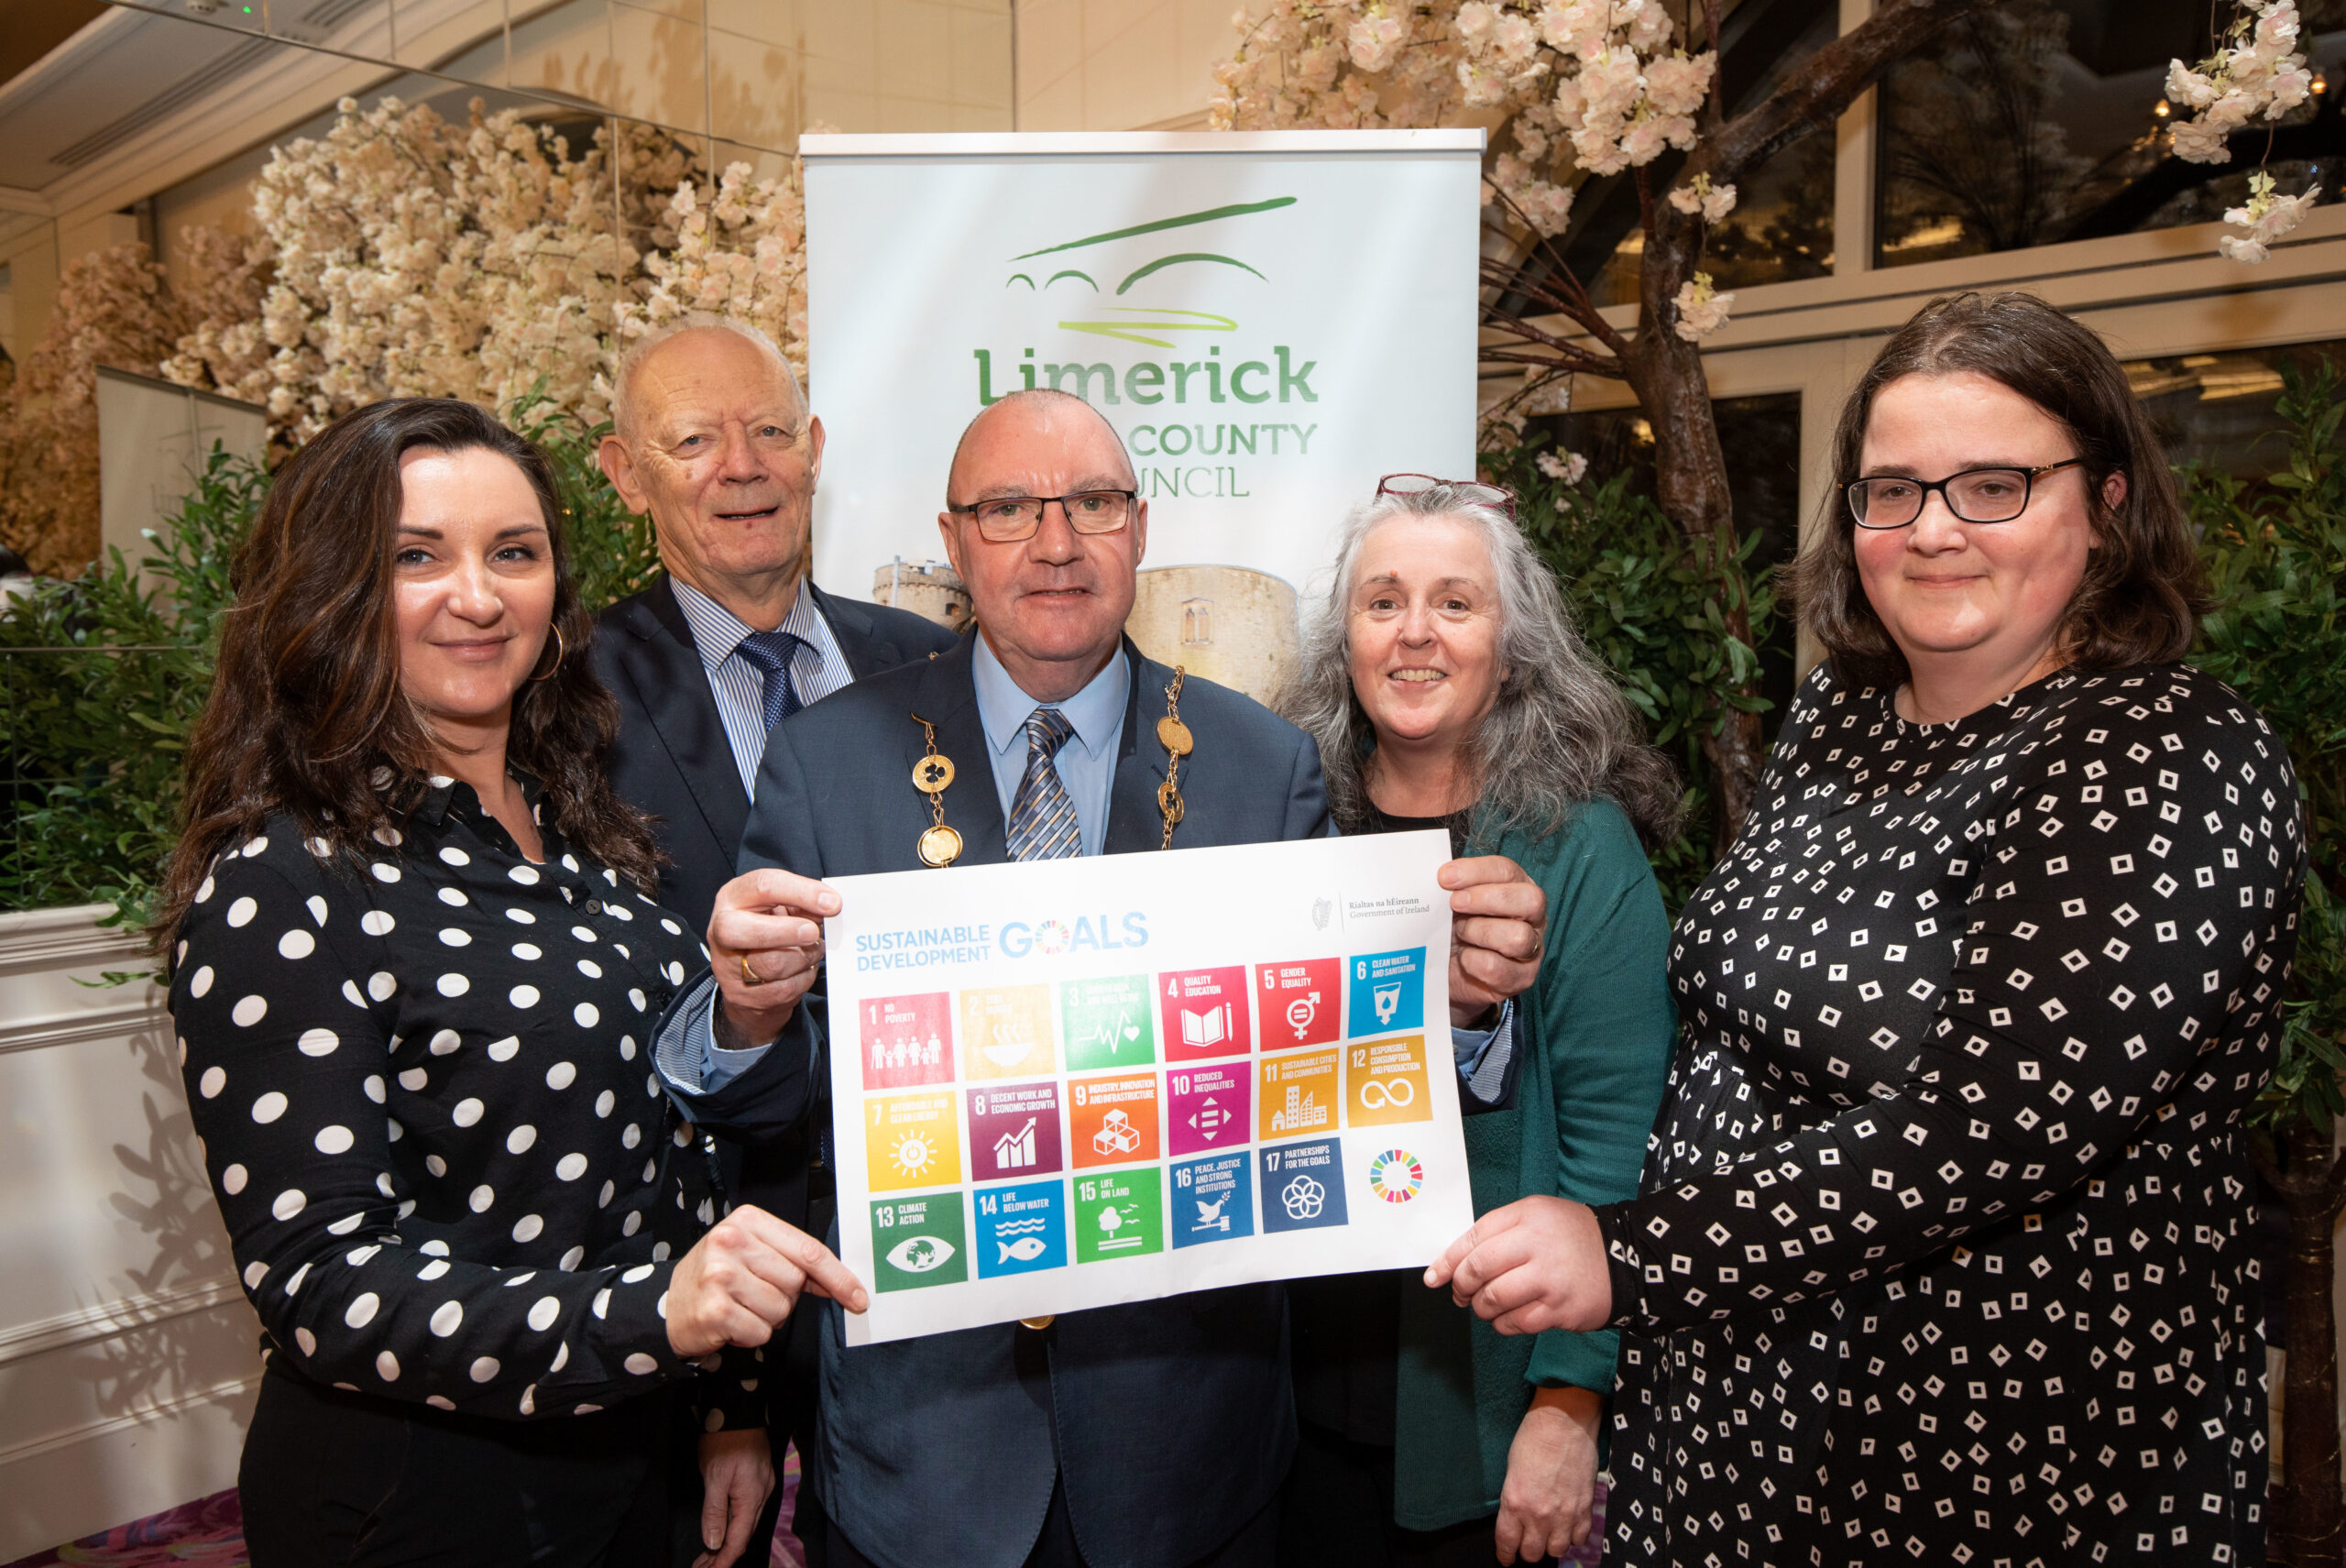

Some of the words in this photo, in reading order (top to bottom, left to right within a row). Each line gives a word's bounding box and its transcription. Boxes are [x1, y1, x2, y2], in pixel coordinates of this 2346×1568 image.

[973, 345, 1319, 405] Limerick
[1128, 423, 1318, 456] COUNTY
[1349, 901, 1375, 910] Rialtas
[1350, 909, 1395, 919] Government
[1396, 906, 1404, 915] of
[1405, 905, 1430, 915] Ireland
[856, 925, 991, 953] SUSTAINABLE
[999, 910, 1149, 959] GOALS
[857, 945, 991, 972] DEVELOPMENT
[1372, 958, 1391, 969] CLEAN
[1391, 955, 1410, 966] WATER
[1280, 967, 1306, 978] GENDER
[1357, 960, 1366, 980] 6
[1372, 969, 1385, 978] AND
[1385, 963, 1416, 976] SANITATION
[1184, 975, 1211, 987] QUALITY
[1264, 969, 1275, 990] 5
[1281, 977, 1311, 989] EQUALITY
[1168, 978, 1178, 998] 4
[1185, 984, 1222, 997] EDUCATION
[1069, 987, 1080, 1007] 3
[884, 1003, 895, 1013] NO
[969, 996, 979, 1016] 2
[869, 1004, 877, 1025] 1
[884, 1012, 915, 1025] POVERTY
[1370, 1043, 1408, 1056] RESPONSIBLE
[1281, 1057, 1320, 1070] SUSTAINABLE
[1320, 1054, 1337, 1064] CITIES
[1352, 1049, 1366, 1068] 12
[1370, 1053, 1411, 1065] CONSUMPTION
[1265, 1063, 1277, 1082] 11
[1282, 1070, 1294, 1080] AND
[1294, 1064, 1332, 1078] COMMUNITIES
[1371, 1064, 1384, 1075] AND
[1384, 1062, 1420, 1074] PRODUCTION
[1194, 1071, 1222, 1083] REDUCED
[1172, 1075, 1189, 1096] 10
[1194, 1080, 1235, 1093] INEQUALITIES
[991, 1092, 1015, 1103] DECENT
[1017, 1090, 1036, 1101] WORK
[1037, 1089, 1052, 1099] AND
[1076, 1085, 1086, 1105] 9
[1090, 1094, 1102, 1105] AND
[1102, 1089, 1155, 1103] INFRASTRUCTURE
[975, 1094, 986, 1115] 8
[992, 1102, 1025, 1114] ECONOMIC
[1026, 1100, 1056, 1111] GROWTH
[872, 1104, 882, 1125] 7
[1285, 1145, 1330, 1159] PARTNERSHIPS
[1216, 1158, 1241, 1171] JUSTICE
[1266, 1152, 1280, 1172] 17
[1285, 1160, 1298, 1169] FOR
[1298, 1157, 1310, 1168] THE
[1310, 1155, 1331, 1167] GOALS
[1101, 1179, 1114, 1189] LIFE
[1175, 1168, 1191, 1189] 16
[1195, 1174, 1208, 1185] AND
[1209, 1170, 1233, 1181] STRONG
[1079, 1181, 1096, 1201] 15
[1101, 1190, 1111, 1200] ON
[1112, 1187, 1130, 1198] LAND
[1195, 1179, 1236, 1195] INSTITUTIONS
[1003, 1191, 1016, 1202] LIFE
[898, 1202, 927, 1214] CLIMATE
[980, 1194, 998, 1216] 14
[1003, 1201, 1026, 1213] BELOW
[1026, 1198, 1049, 1210] WATER
[875, 1206, 894, 1228] 13
[899, 1214, 925, 1225] ACTION
